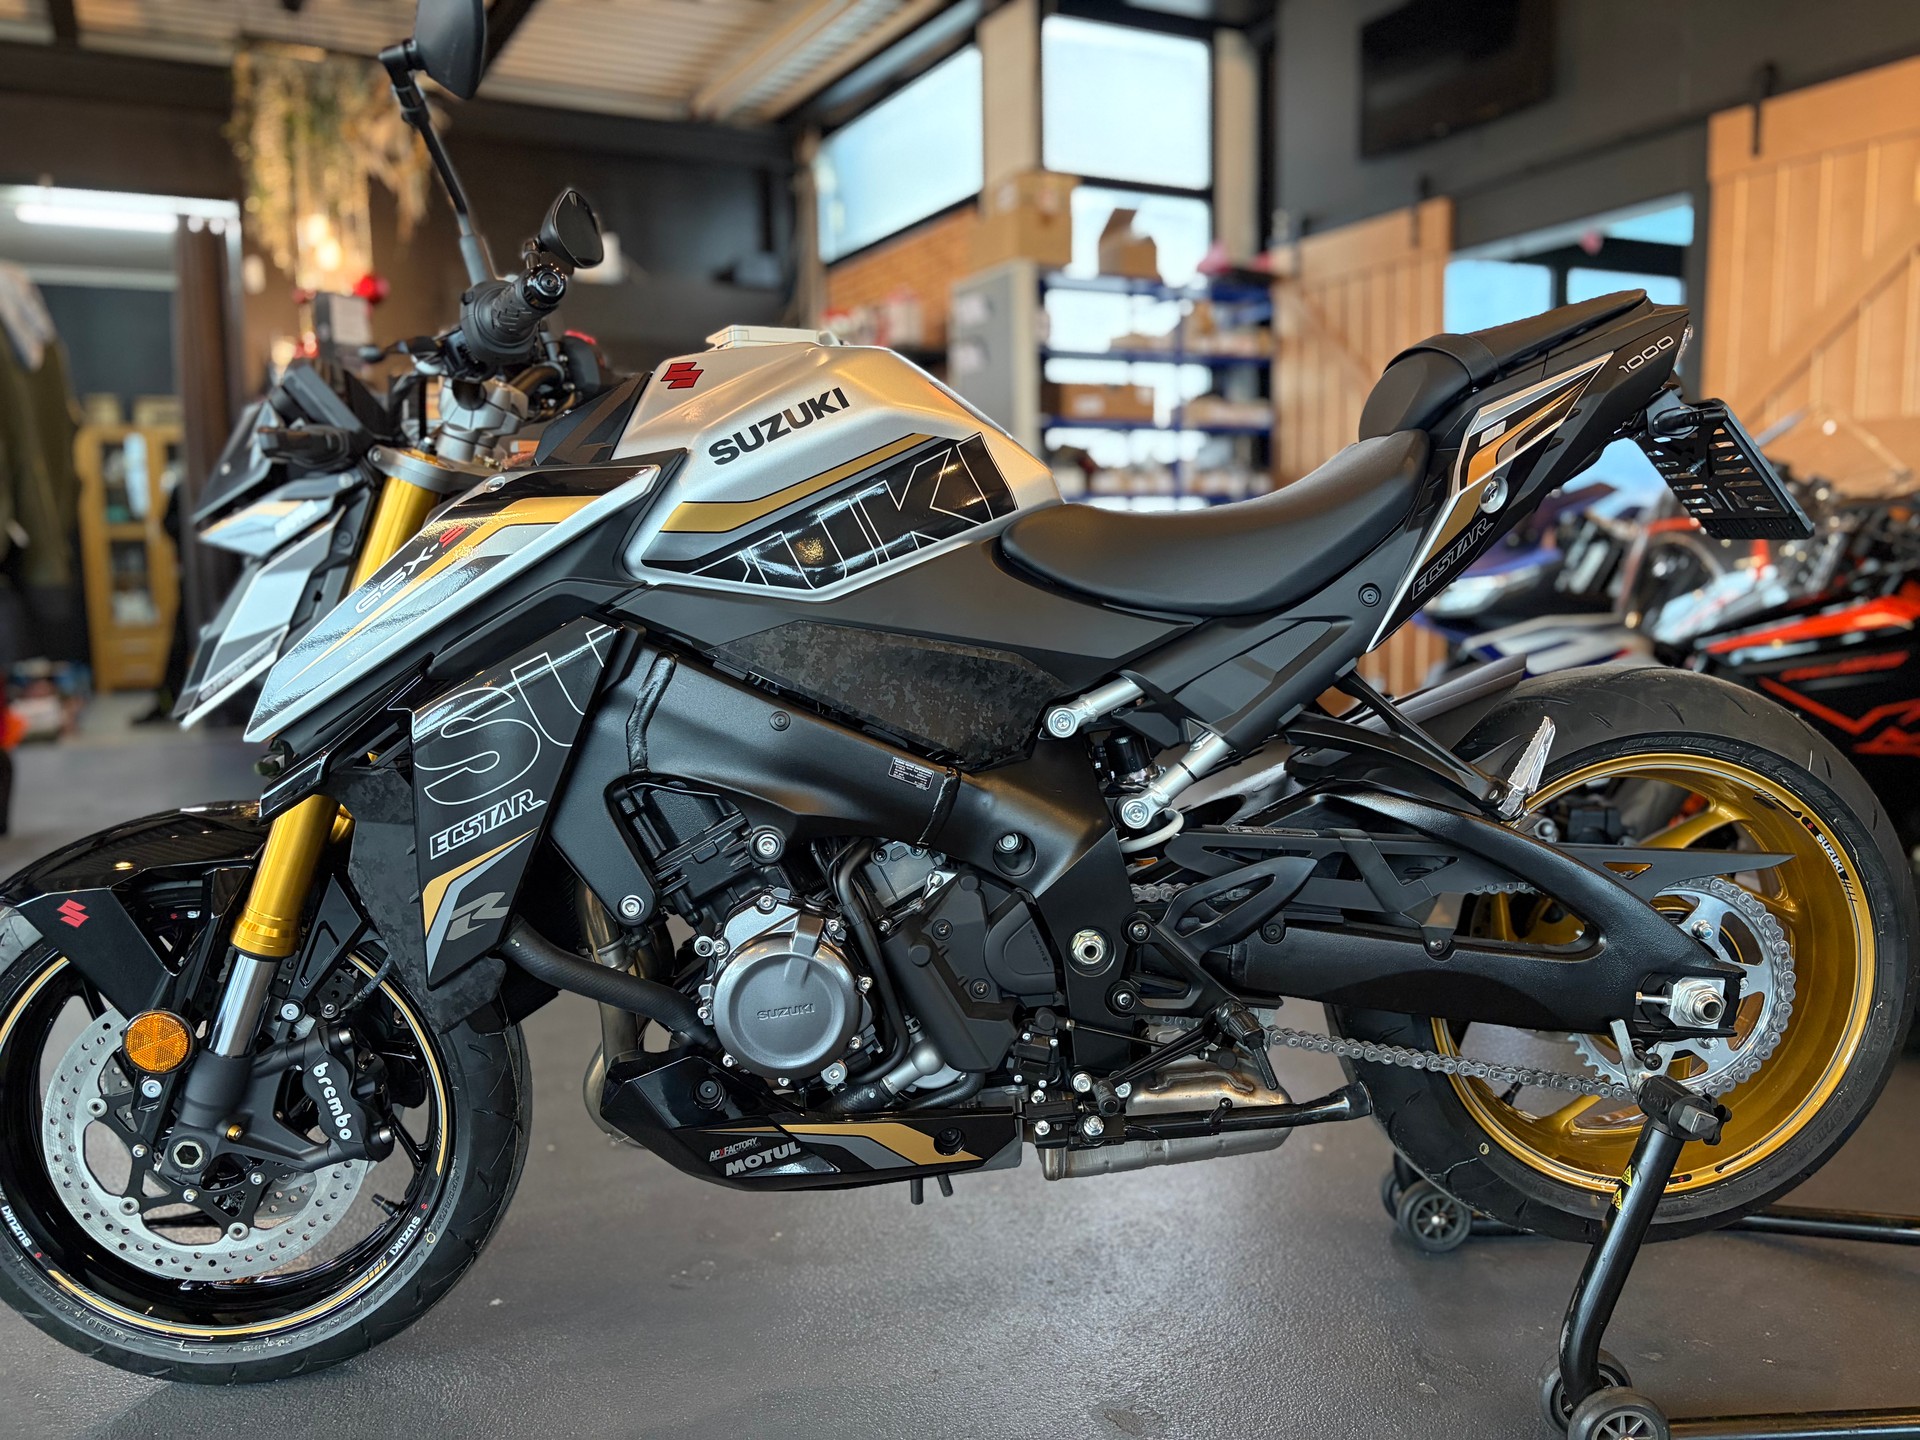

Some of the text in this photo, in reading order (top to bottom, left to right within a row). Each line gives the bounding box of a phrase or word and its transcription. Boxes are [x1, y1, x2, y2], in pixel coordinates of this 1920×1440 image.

[1618, 335, 1675, 374] 1000
[708, 387, 850, 465] SUZUKI
[355, 525, 467, 613] GSX-S
[1412, 517, 1494, 600] ECSTAR
[429, 788, 548, 860] ECSTAR
[1816, 833, 1845, 873] SUZUKI
[757, 1003, 815, 1021] SUZUKI
[313, 1061, 352, 1140] brembo
[725, 1141, 801, 1177] MOTUL
[1, 1205, 32, 1247] SUZUKI
[389, 1215, 421, 1256] SUZUKI
